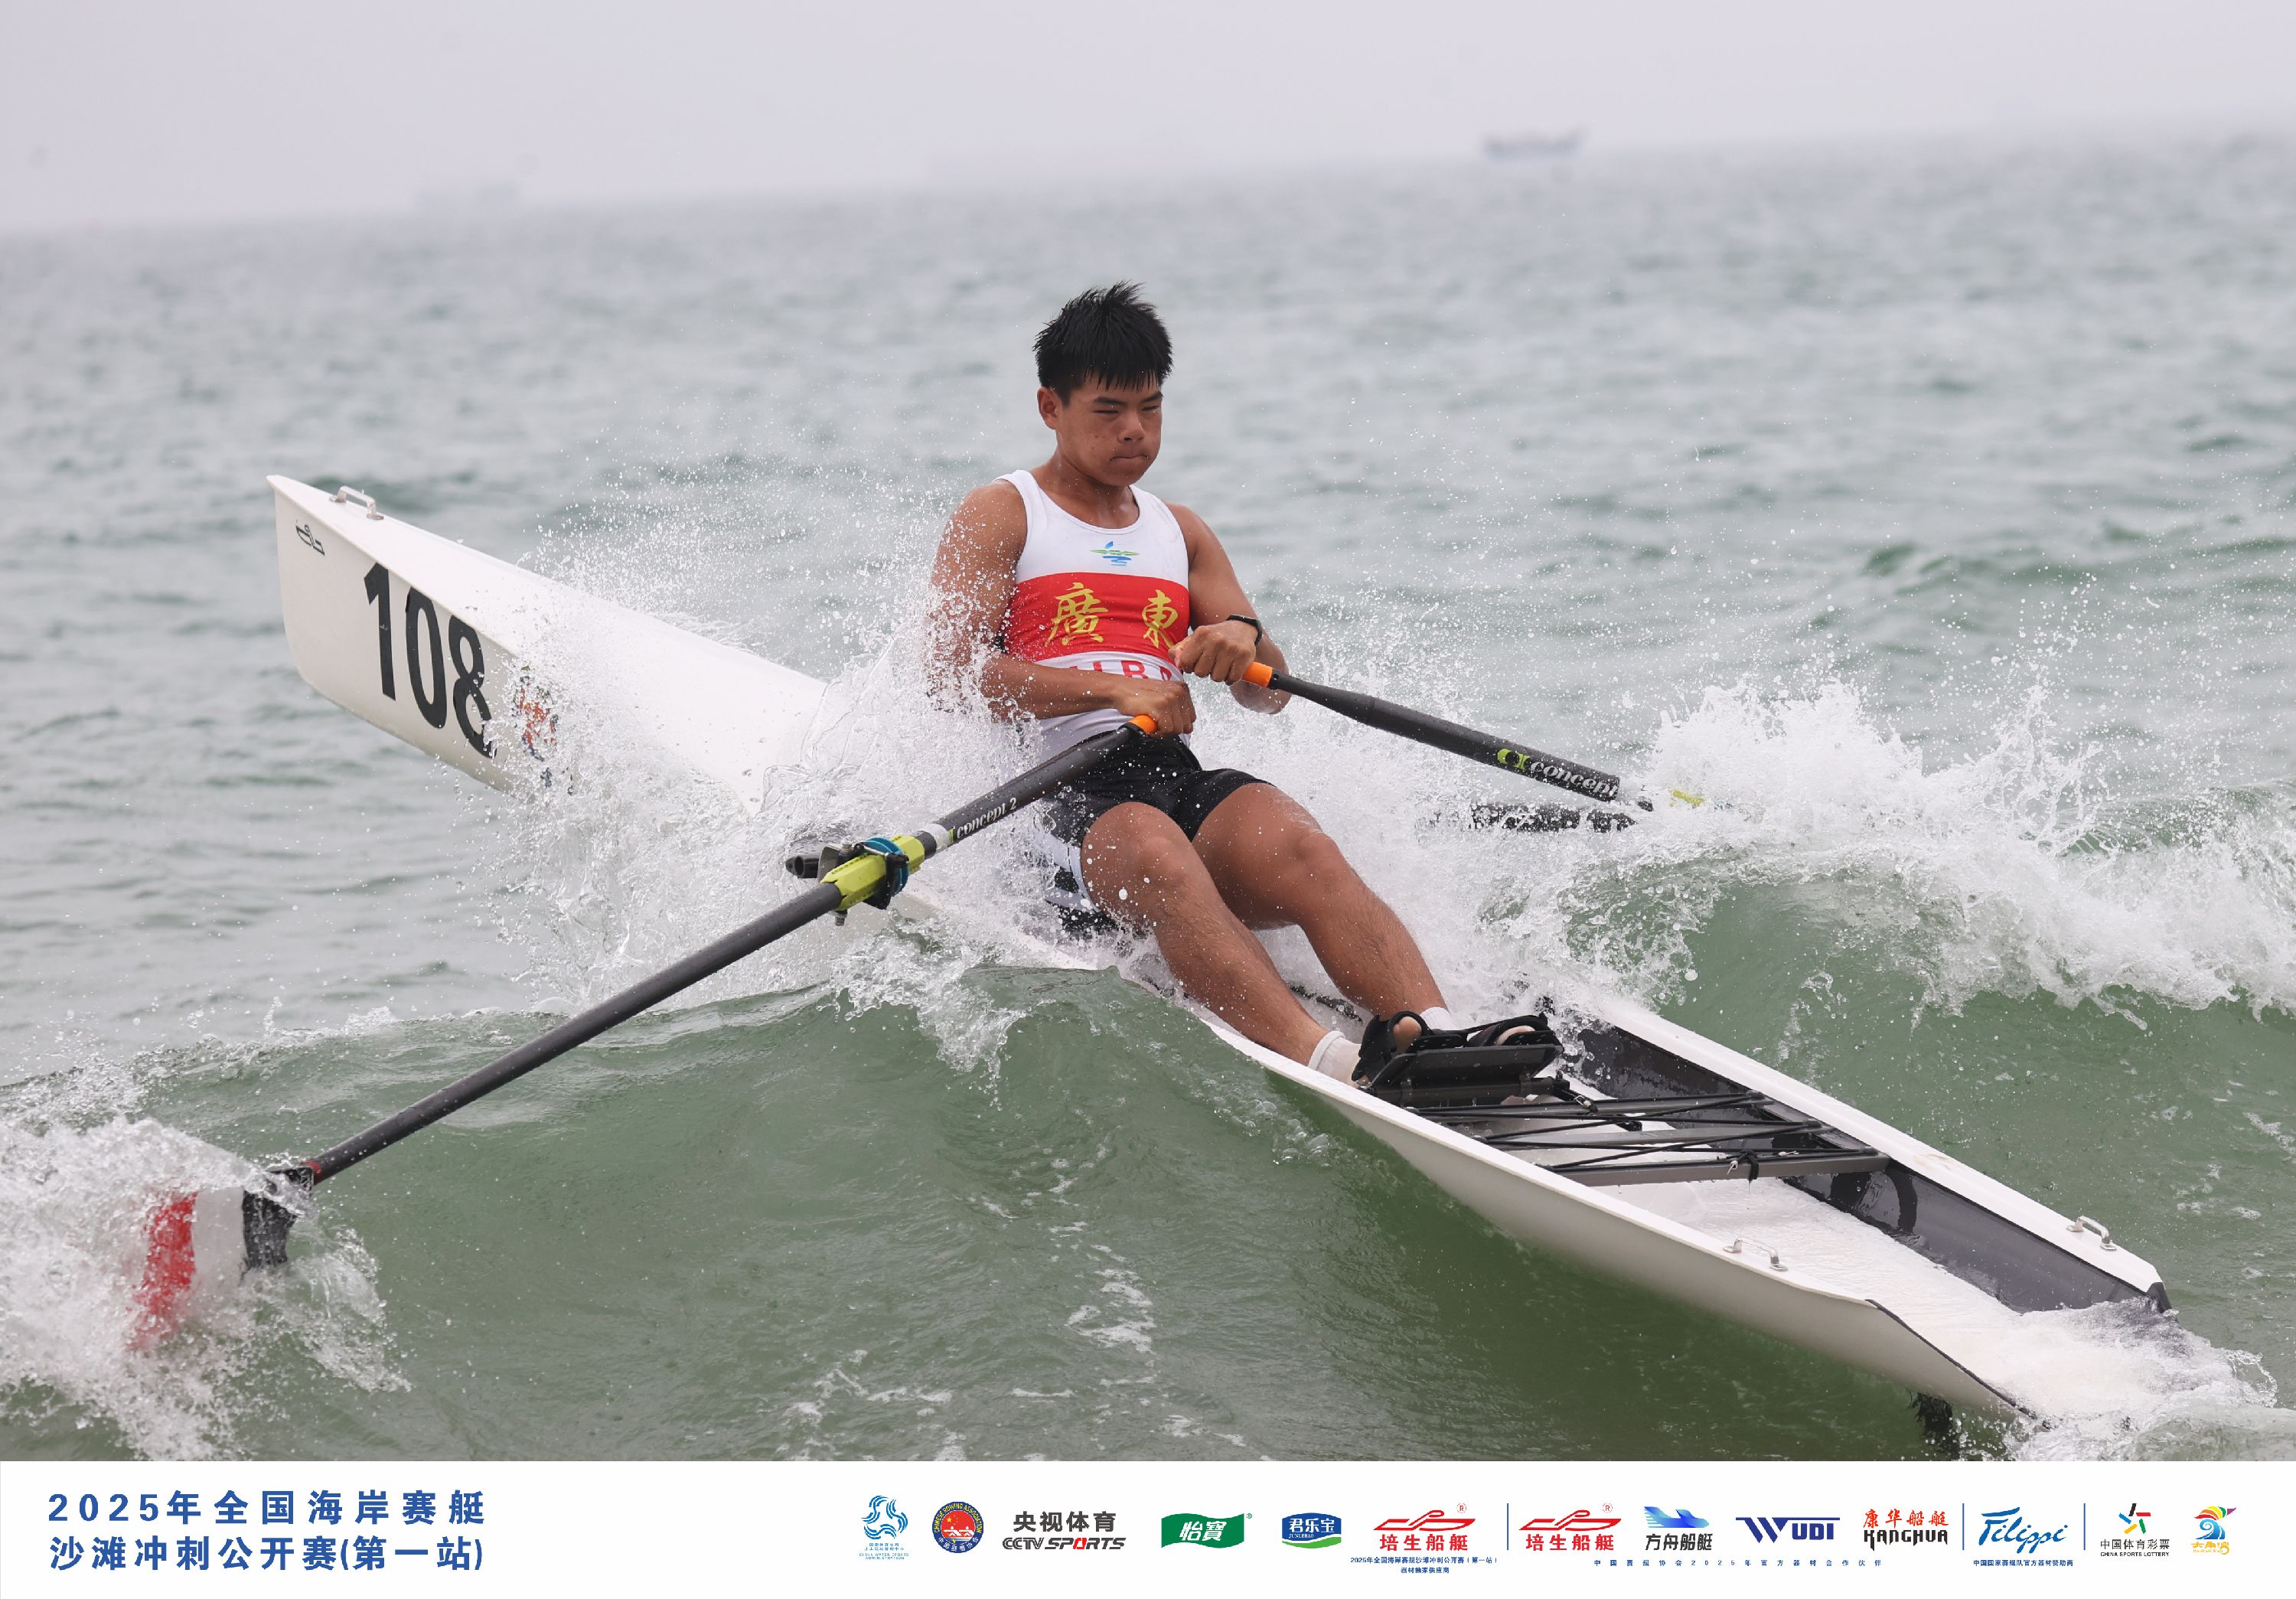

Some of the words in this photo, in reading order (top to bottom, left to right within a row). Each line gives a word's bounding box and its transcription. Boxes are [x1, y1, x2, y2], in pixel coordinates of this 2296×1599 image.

[1045, 582, 1179, 648] 廣東
[364, 562, 497, 759] 108
[957, 802, 1007, 839] concept
[1009, 797, 1017, 811] 2
